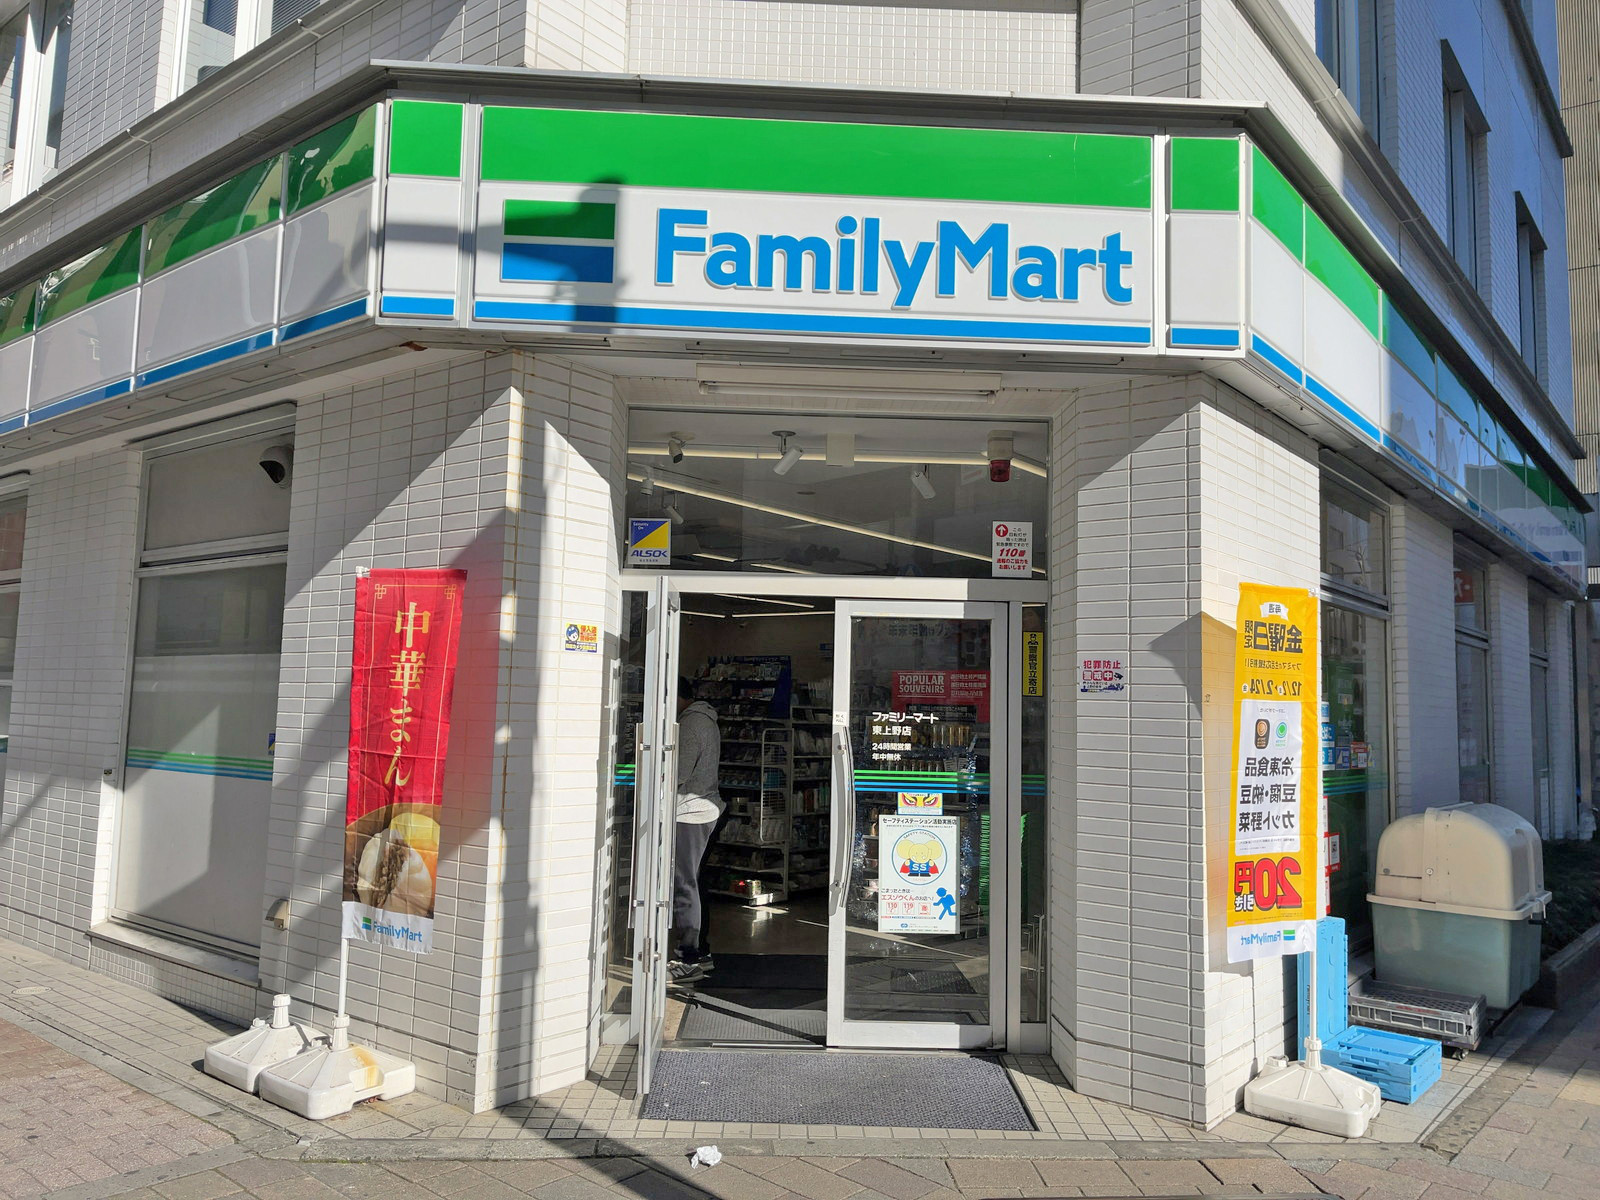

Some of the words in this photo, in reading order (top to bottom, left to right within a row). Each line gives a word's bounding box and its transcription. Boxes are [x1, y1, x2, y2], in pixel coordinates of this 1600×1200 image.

[654, 207, 1133, 309] FamilyMart
[999, 548, 1026, 557] 110番
[1083, 660, 1121, 669] 犯罪防止
[899, 675, 945, 685] POPULAR
[384, 601, 431, 787] 中華まん
[899, 684, 945, 694] SOUVENIRS
[872, 712, 939, 724] ファミリーマート
[872, 726, 912, 736] 東上野店
[872, 743, 912, 751] 24時間営業
[872, 753, 902, 761] 年中無休
[883, 817, 957, 825] セーフティステーション活動実施店
[912, 863, 927, 871] SS
[373, 920, 423, 942] FamilyMart
